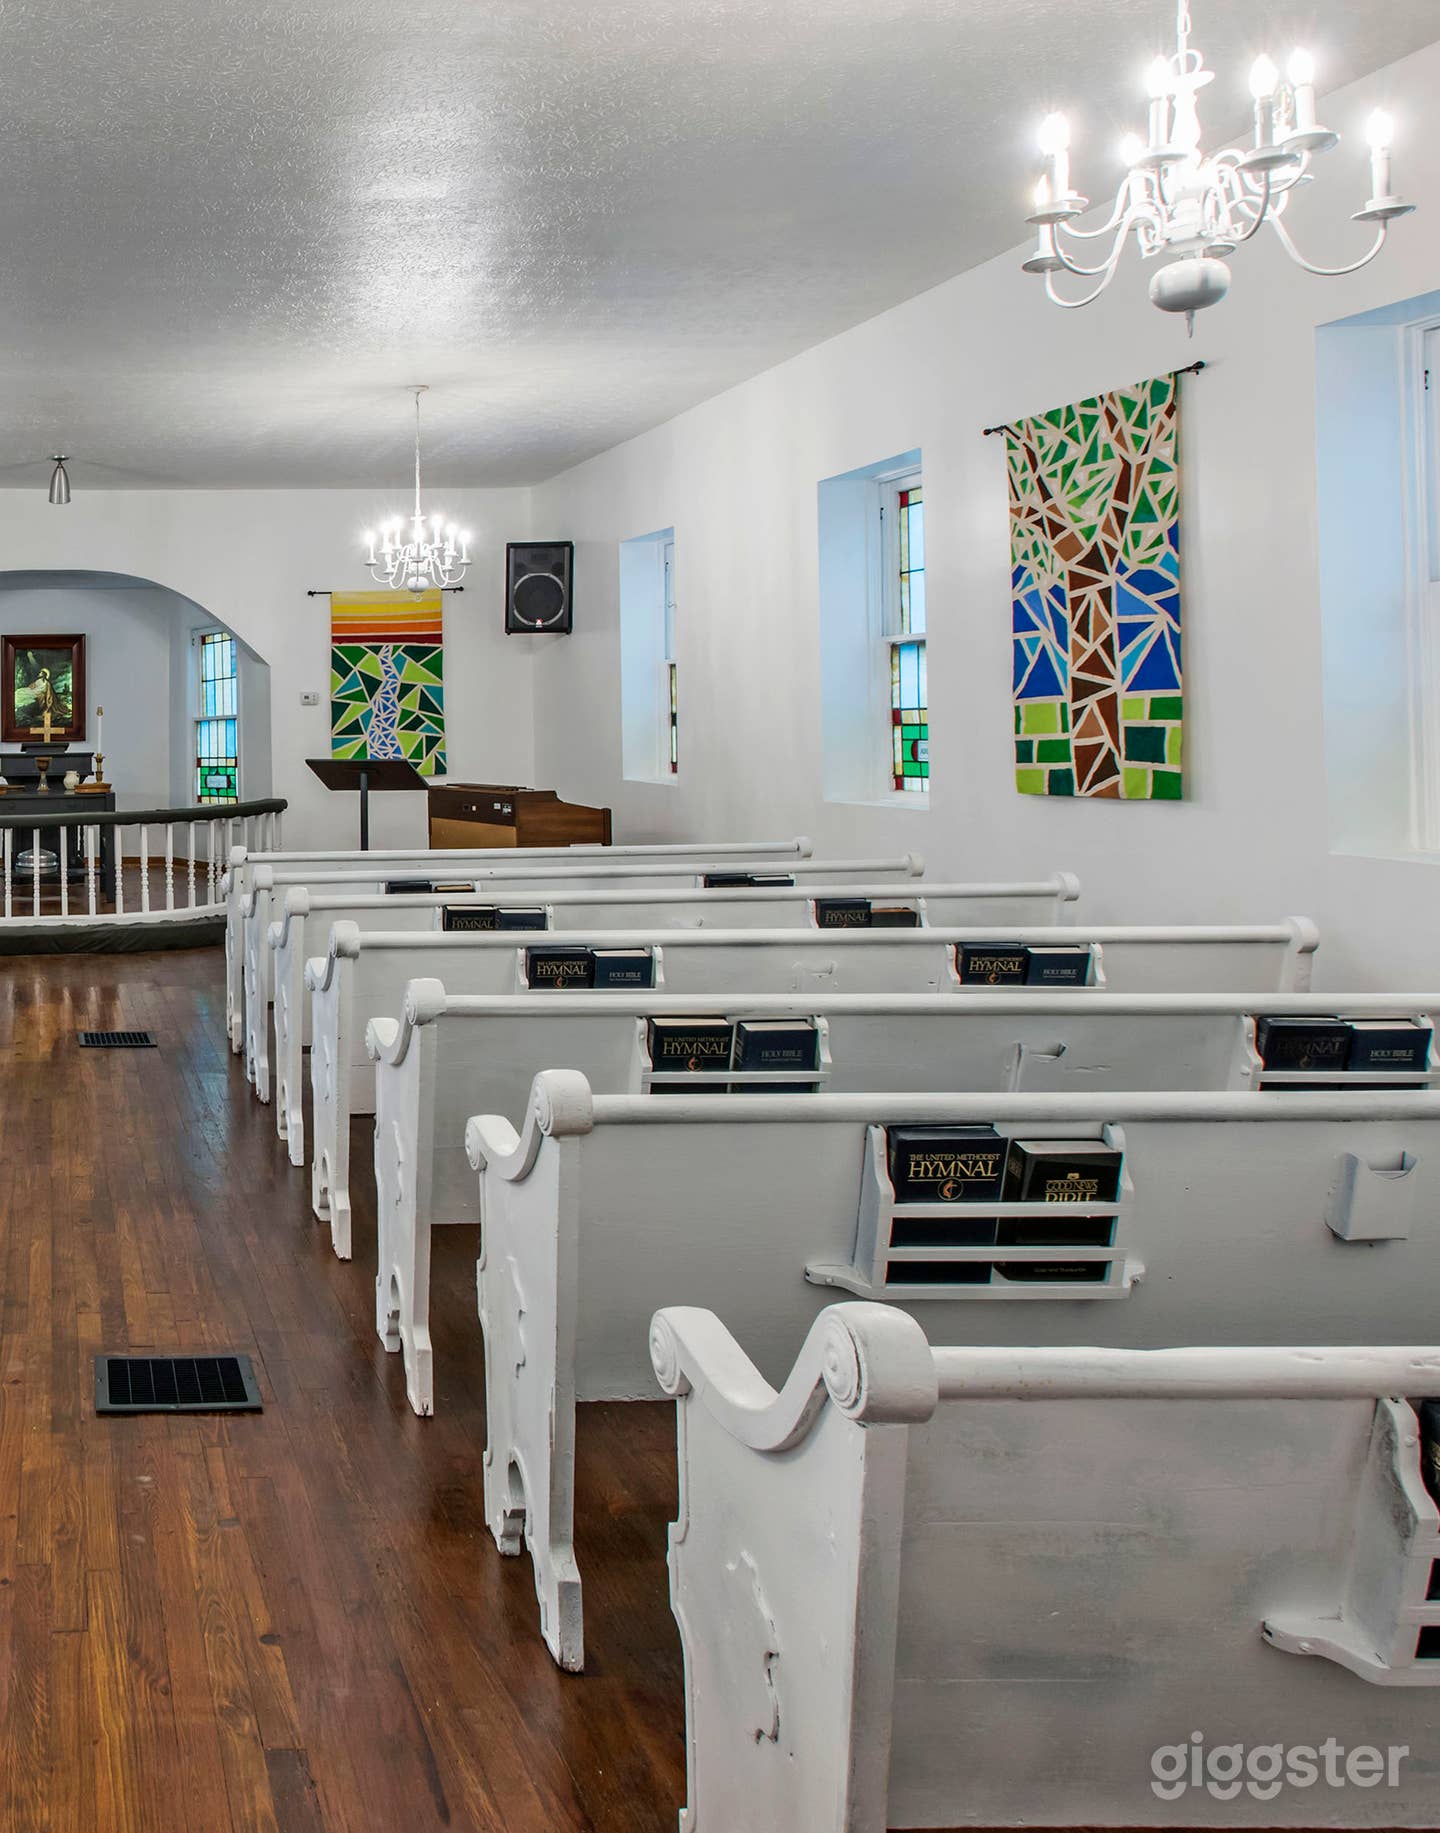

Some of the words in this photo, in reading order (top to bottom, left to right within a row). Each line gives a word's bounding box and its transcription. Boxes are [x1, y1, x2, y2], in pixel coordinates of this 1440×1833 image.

[537, 964, 588, 975] HYMNAL
[968, 961, 1022, 971] HYMNAL
[663, 1041, 728, 1055] HYMNAL
[908, 1160, 999, 1178] HYMNAL
